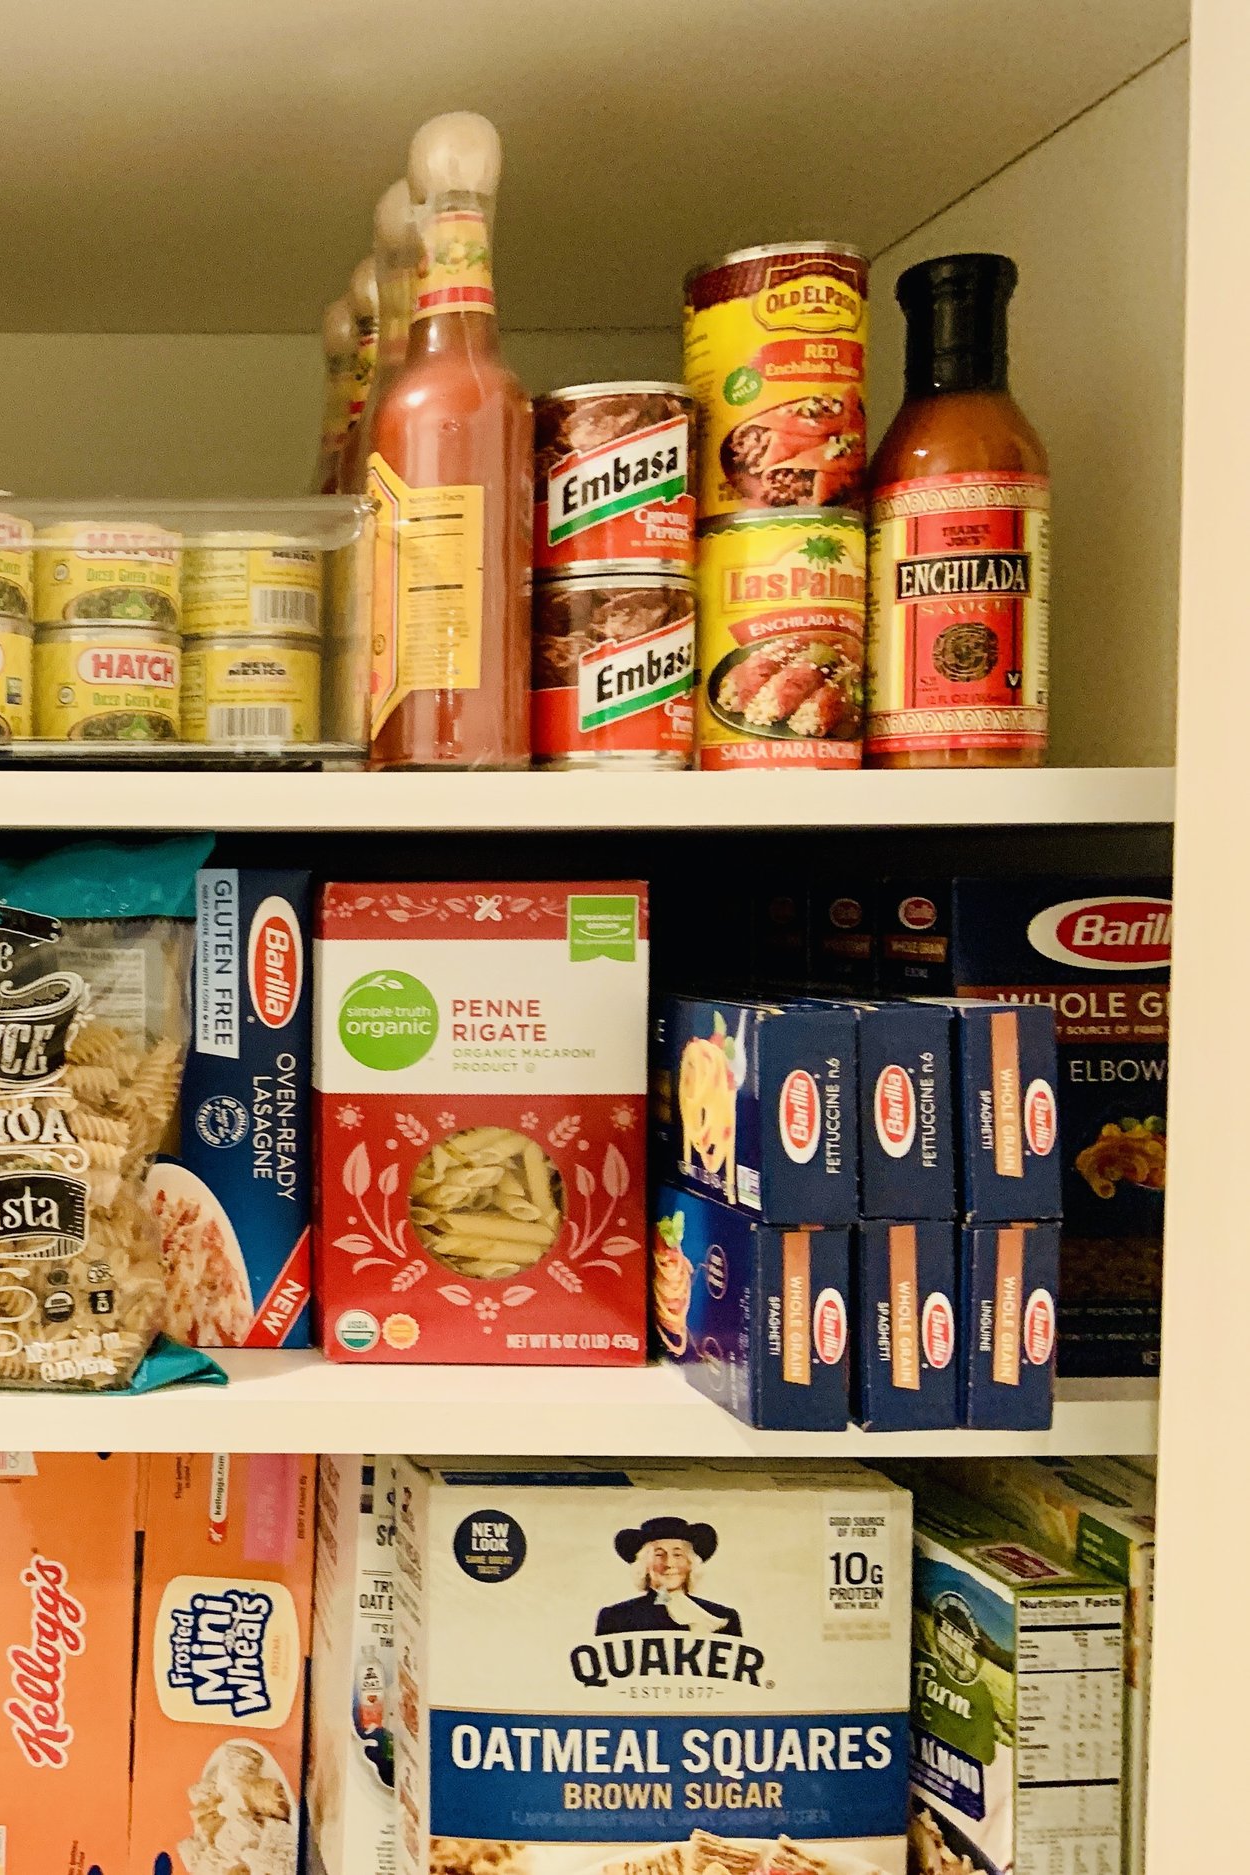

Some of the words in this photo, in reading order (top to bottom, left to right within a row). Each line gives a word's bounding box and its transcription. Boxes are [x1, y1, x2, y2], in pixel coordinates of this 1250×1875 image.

[766, 291, 801, 315] OLD
[803, 285, 824, 301] EL
[764, 361, 832, 377] Enchilada
[804, 344, 839, 360] RED
[731, 380, 759, 402] MILD
[561, 445, 679, 516] Embasa
[86, 531, 175, 562] HATCH
[729, 571, 788, 603] Las
[900, 559, 1027, 598] ENCHILADA
[748, 614, 837, 639] ENCHILADA
[920, 601, 1010, 616] SAUCE
[91, 653, 175, 684] HATCH
[228, 667, 287, 677] MEXICO
[1006, 673, 1021, 687] V
[720, 743, 768, 762] SALSA
[771, 742, 816, 760] PARA
[213, 879, 234, 975] GLUTEN
[264, 926, 293, 1018] Barilla
[214, 987, 234, 1047] FREE
[345, 1017, 432, 1039] organic
[346, 1005, 393, 1020] simple
[394, 1005, 431, 1018] truth
[452, 999, 541, 1018] PENNE
[996, 992, 1128, 1019] WHOLE
[452, 1023, 547, 1042] RIGATE
[1065, 1025, 1111, 1035] SOURCE
[452, 1049, 517, 1059] ORGANIC
[521, 1049, 596, 1059] MACARONI
[452, 1062, 519, 1072] PRODUCT
[789, 1075, 810, 1142] Barilla
[884, 1071, 903, 1138] Barilla
[998, 1067, 1016, 1121] WHOLE
[252, 1076, 273, 1179] LASAGNE
[276, 1052, 297, 1201] OVEN-READY
[825, 1090, 841, 1174] FETTUCCINE
[922, 1083, 937, 1169] FETTUCCINE
[980, 1090, 994, 1151] SPAGHETTI
[1033, 1095, 1049, 1153] Barilla
[1002, 1123, 1017, 1171] GRAIN
[262, 1278, 305, 1337] NEW
[788, 1275, 804, 1329] WHOLE
[895, 1280, 912, 1334] WHOLE
[1000, 1275, 1017, 1329] WHOLE
[506, 1334, 528, 1349] NET
[529, 1334, 548, 1348] WT
[767, 1296, 781, 1356] SPAGHETTI
[817, 1304, 839, 1363] Barilla
[876, 1302, 891, 1362] SPAGHETTI
[928, 1308, 951, 1367] Barilla
[979, 1300, 993, 1352] LINGUINE
[1031, 1305, 1048, 1363] Barilla
[791, 1331, 805, 1378] GRAIN
[899, 1336, 913, 1383] GRAIN
[999, 1331, 1016, 1378] GRAIN
[214, 1453, 226, 1516] kelloggs.com
[470, 1521, 510, 1539] NEW
[470, 1537, 510, 1553] LOOK
[829, 1516, 851, 1527] GOOD
[836, 1527, 848, 1538] OF
[851, 1527, 877, 1538] FIBER
[358, 1593, 384, 1612] OAT
[829, 1587, 884, 1601] PROTEIN
[1019, 1598, 1079, 1609] Nutrition
[1083, 1597, 1121, 1608] Facts
[8, 1559, 82, 1765] Kellogg's
[171, 1609, 194, 1687] Frosted
[194, 1592, 240, 1701] Mini
[233, 1592, 270, 1717] Wheats
[569, 1637, 767, 1690] QUAKER
[916, 1662, 972, 1720] Farm
[451, 1725, 670, 1774] OATMEAL
[681, 1726, 893, 1780] SQUARES
[921, 1737, 981, 1796] ALMOND
[563, 1783, 672, 1810] BROWN
[684, 1782, 784, 1809] SUGAR
